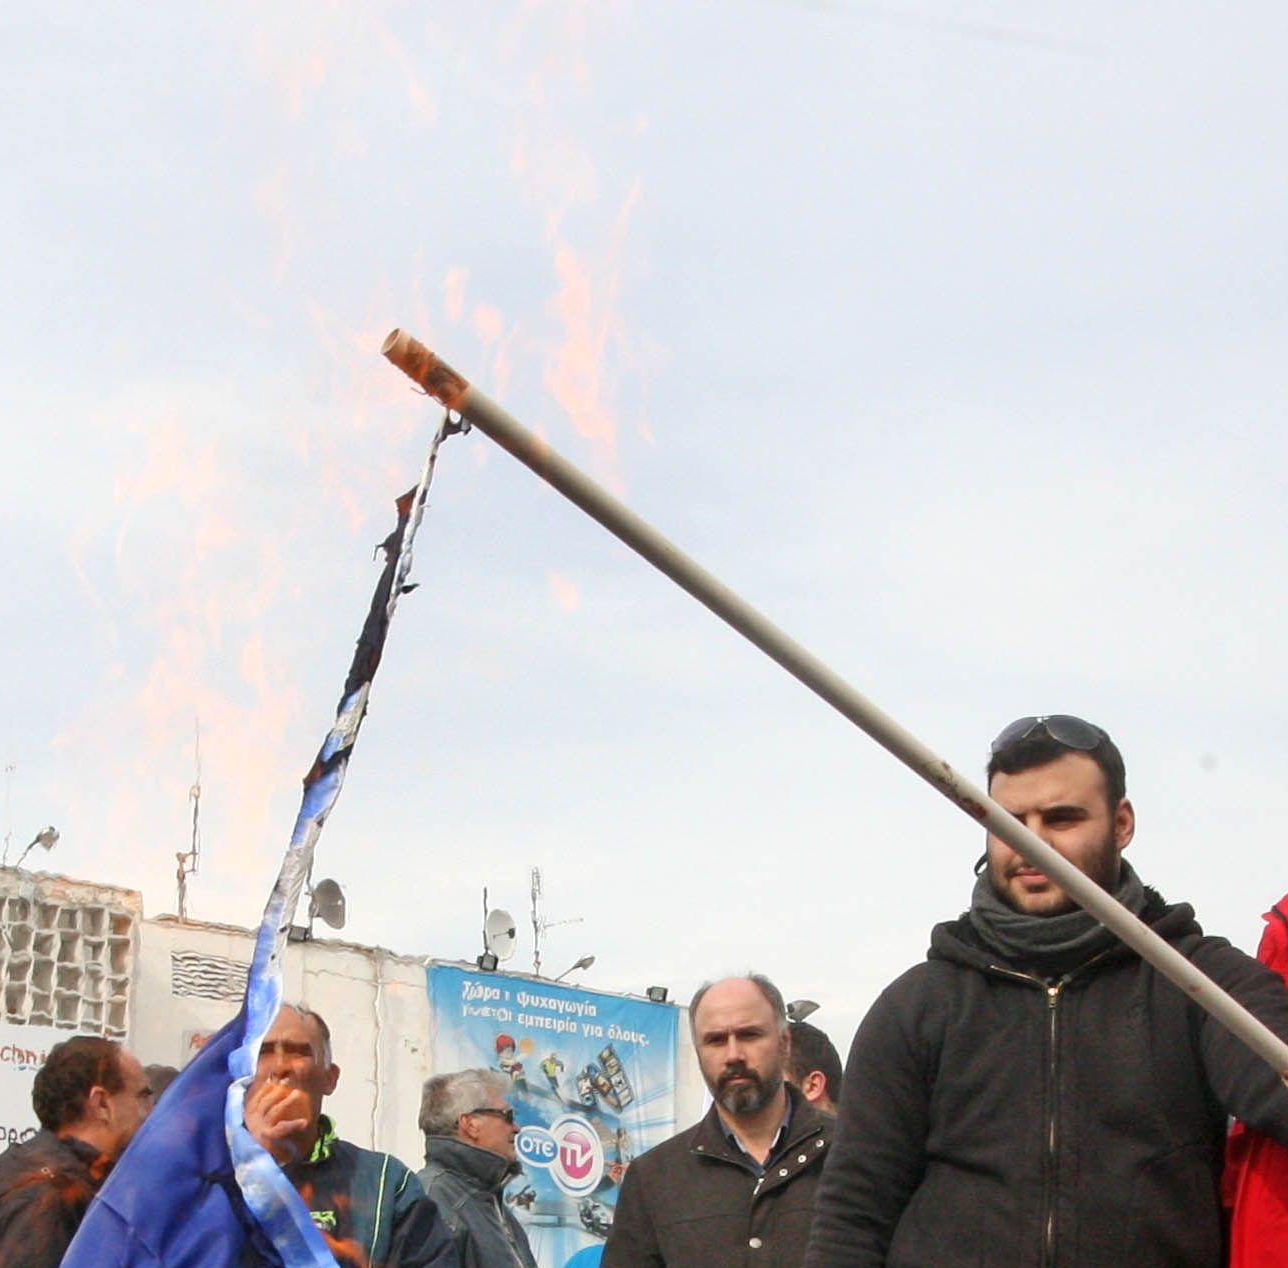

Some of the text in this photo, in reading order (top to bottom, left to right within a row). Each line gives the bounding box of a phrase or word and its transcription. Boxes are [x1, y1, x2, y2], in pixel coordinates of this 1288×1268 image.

[516, 991, 597, 1016] ψυχαγωγία
[517, 1013, 578, 1033] εμπειρία
[582, 1024, 603, 1039] για
[608, 1023, 650, 1047] όλους.
